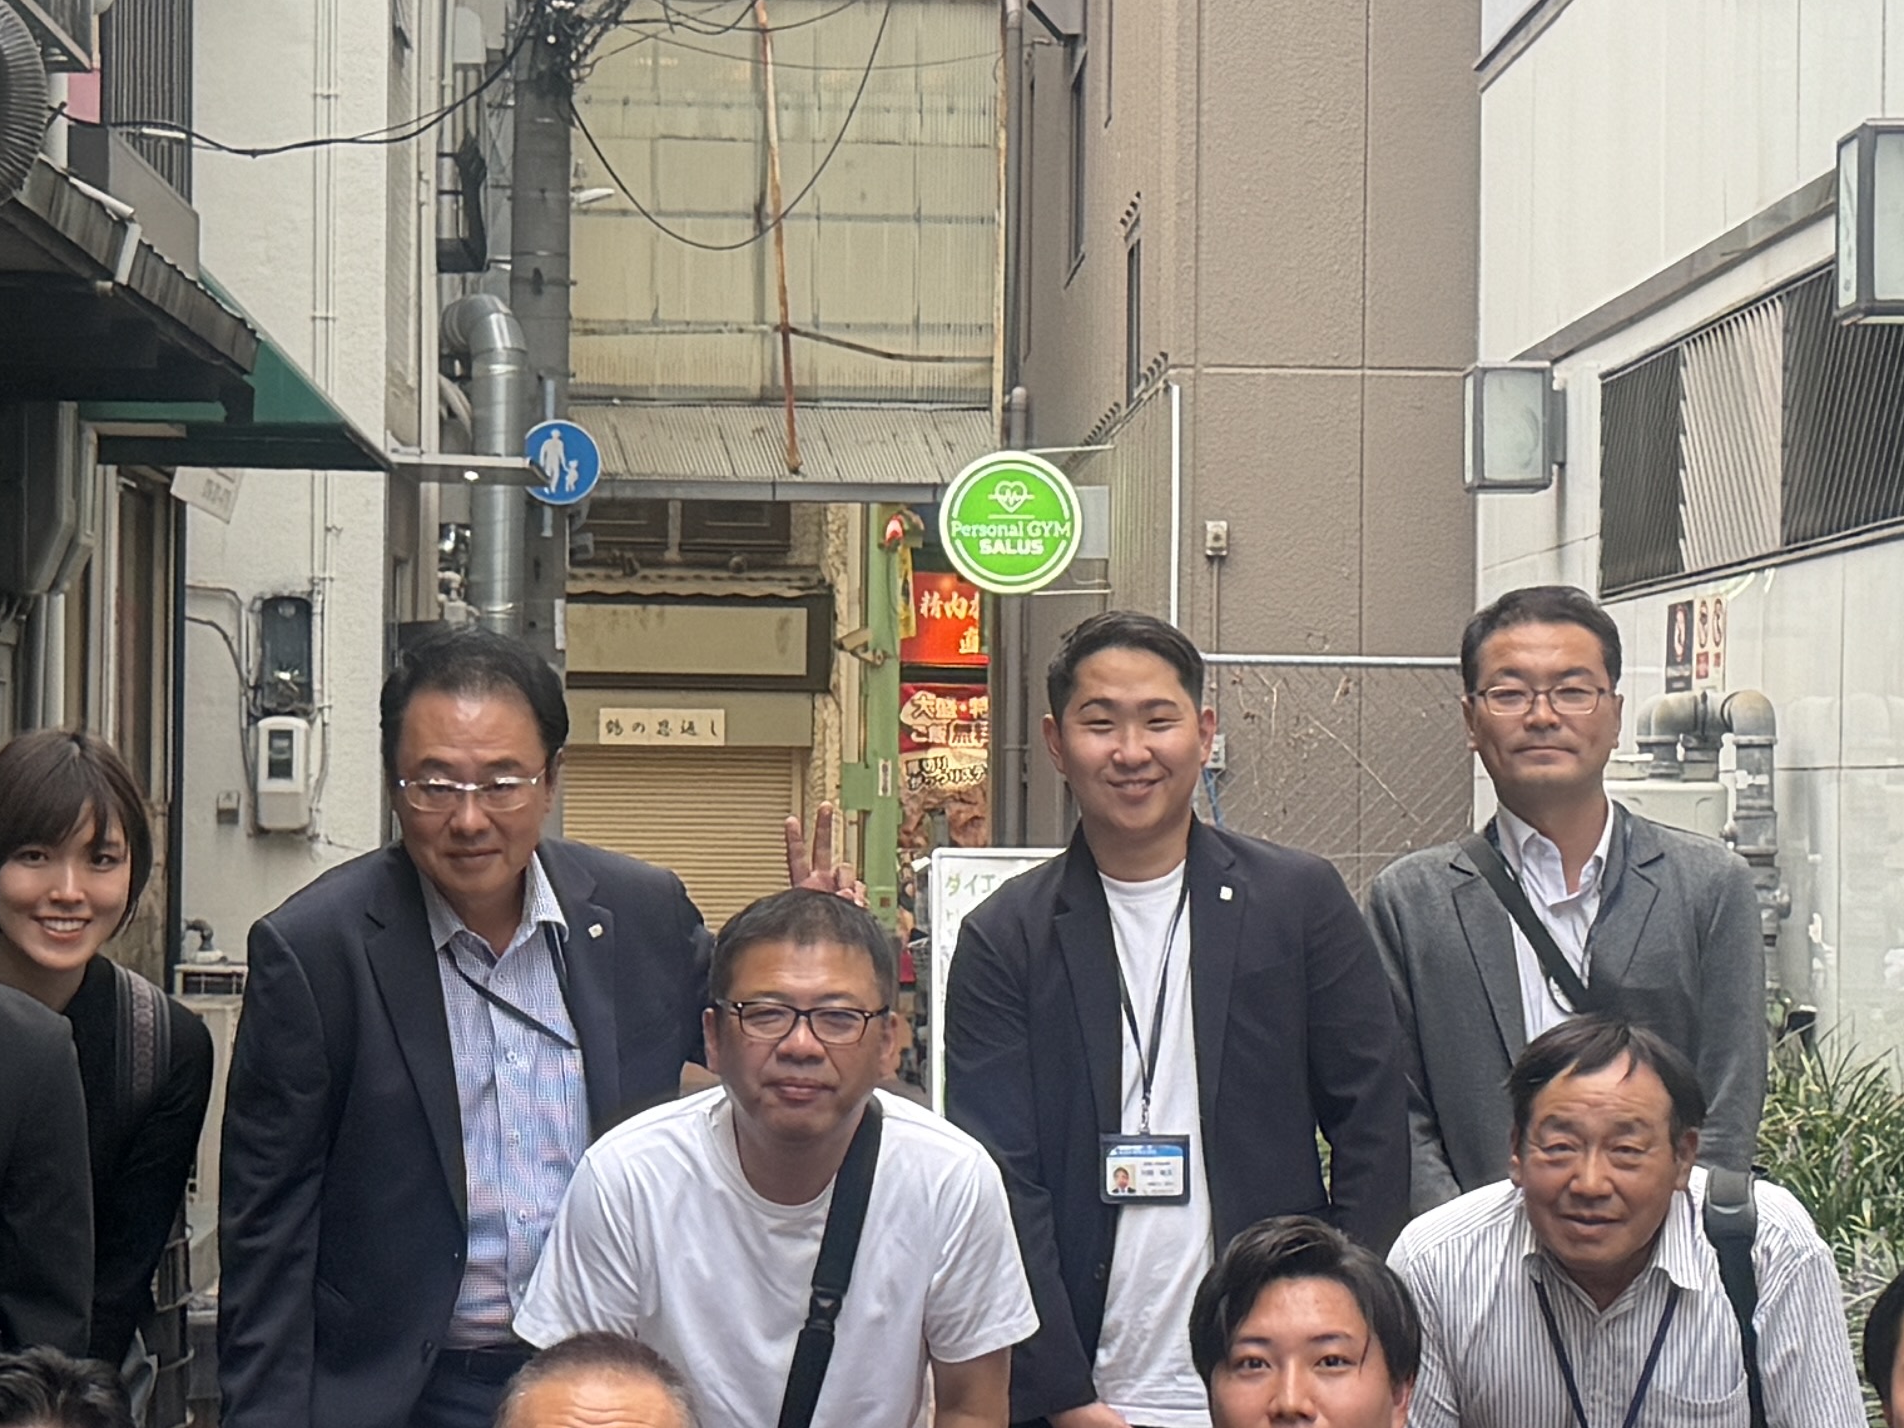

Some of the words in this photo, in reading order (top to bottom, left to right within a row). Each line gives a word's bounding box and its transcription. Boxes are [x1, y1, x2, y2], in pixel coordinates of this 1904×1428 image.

[951, 520, 1024, 538] Personal
[1026, 520, 1071, 538] GYM
[979, 538, 1045, 556] SALUS
